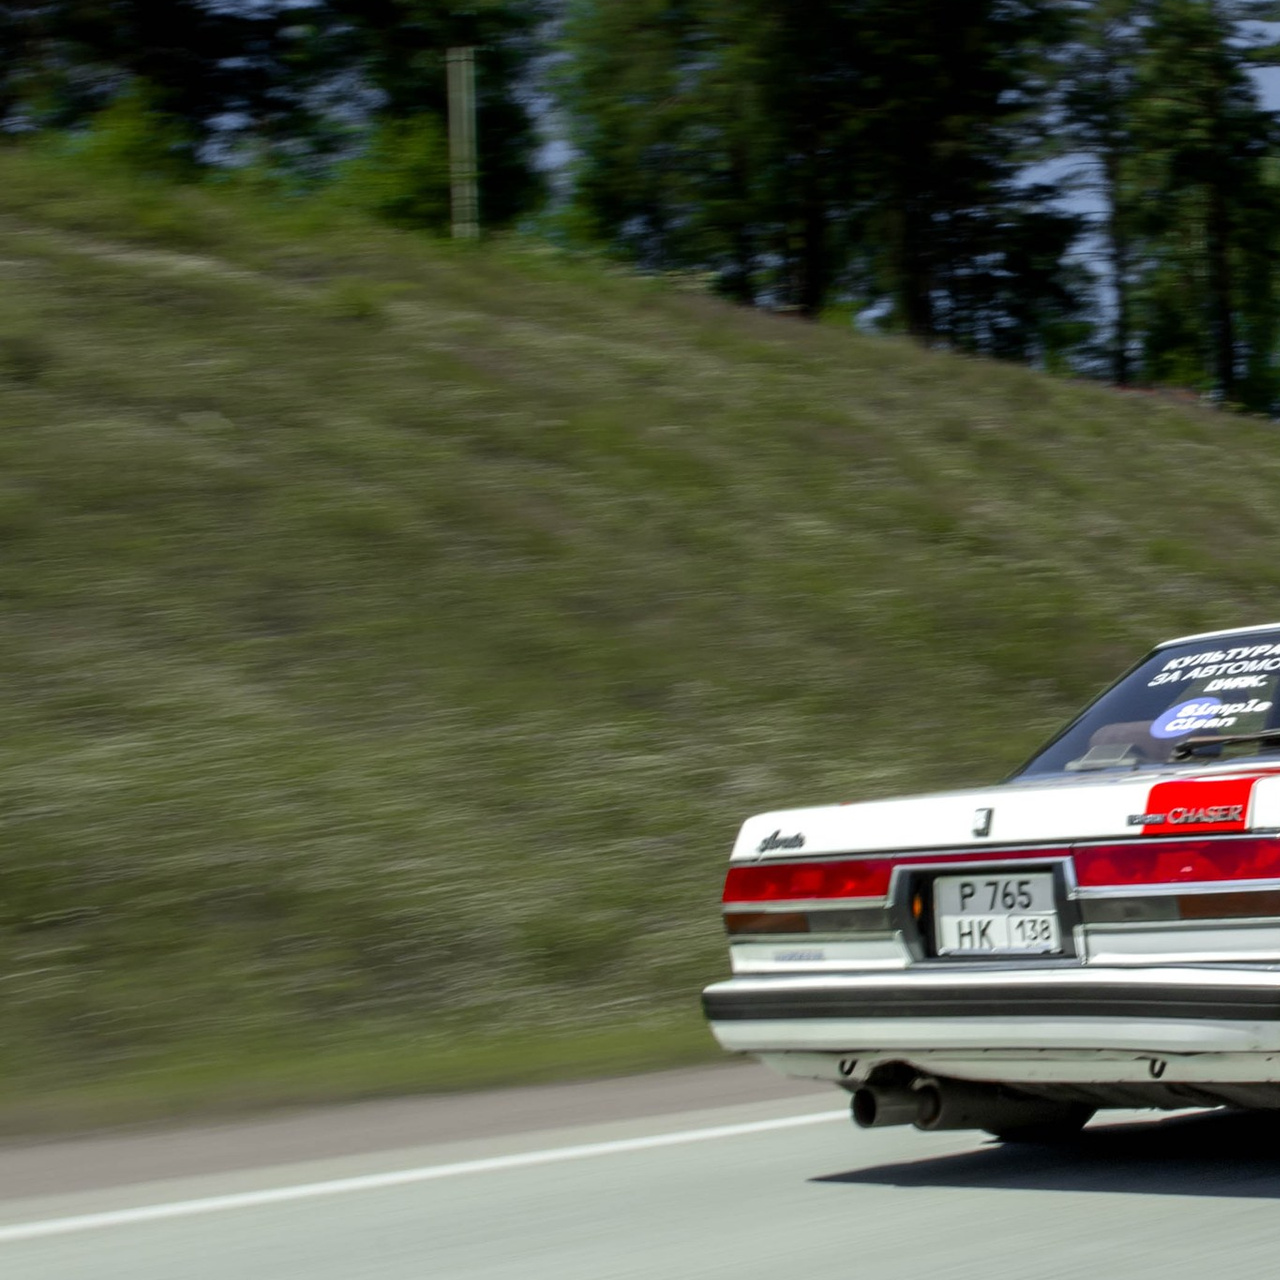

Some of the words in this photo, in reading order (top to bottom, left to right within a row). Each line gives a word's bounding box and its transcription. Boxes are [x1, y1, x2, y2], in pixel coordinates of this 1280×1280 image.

[1147, 671, 1181, 687] ЗА
[1176, 698, 1274, 718] Simple
[1164, 716, 1239, 732] Clean
[1166, 804, 1244, 825] CHASER
[984, 880, 1033, 911] 765
[1014, 919, 1052, 942] 138
